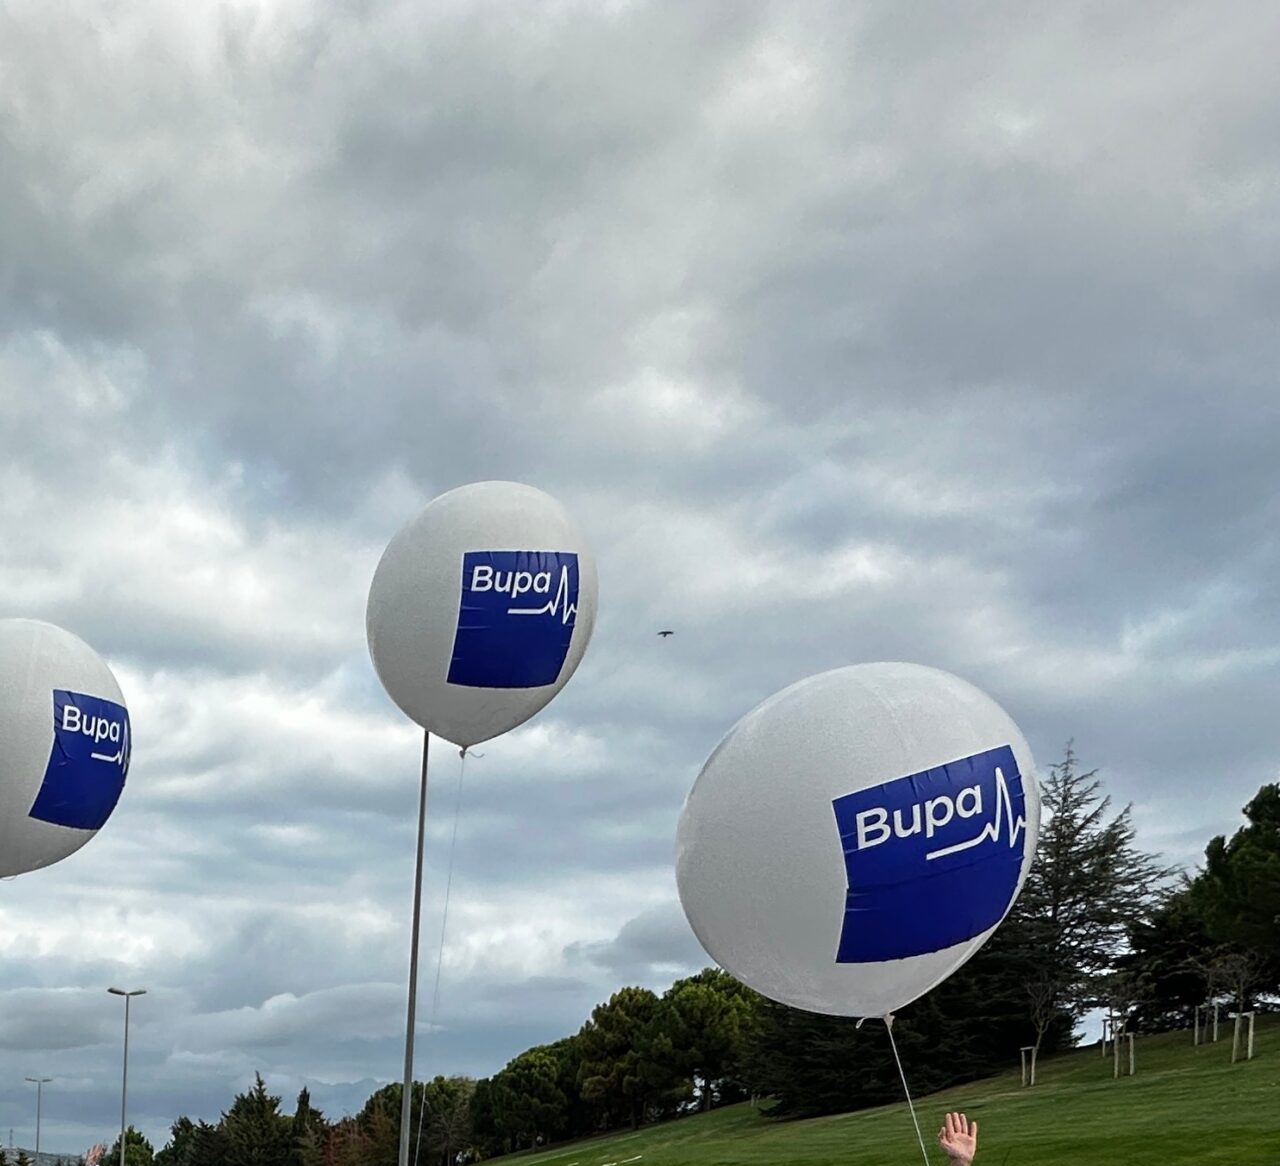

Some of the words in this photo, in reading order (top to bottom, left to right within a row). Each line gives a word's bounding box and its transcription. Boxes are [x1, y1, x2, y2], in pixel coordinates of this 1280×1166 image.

[470, 565, 551, 598] Bupa
[62, 704, 120, 743] Bupa
[855, 784, 983, 850] Bupa
